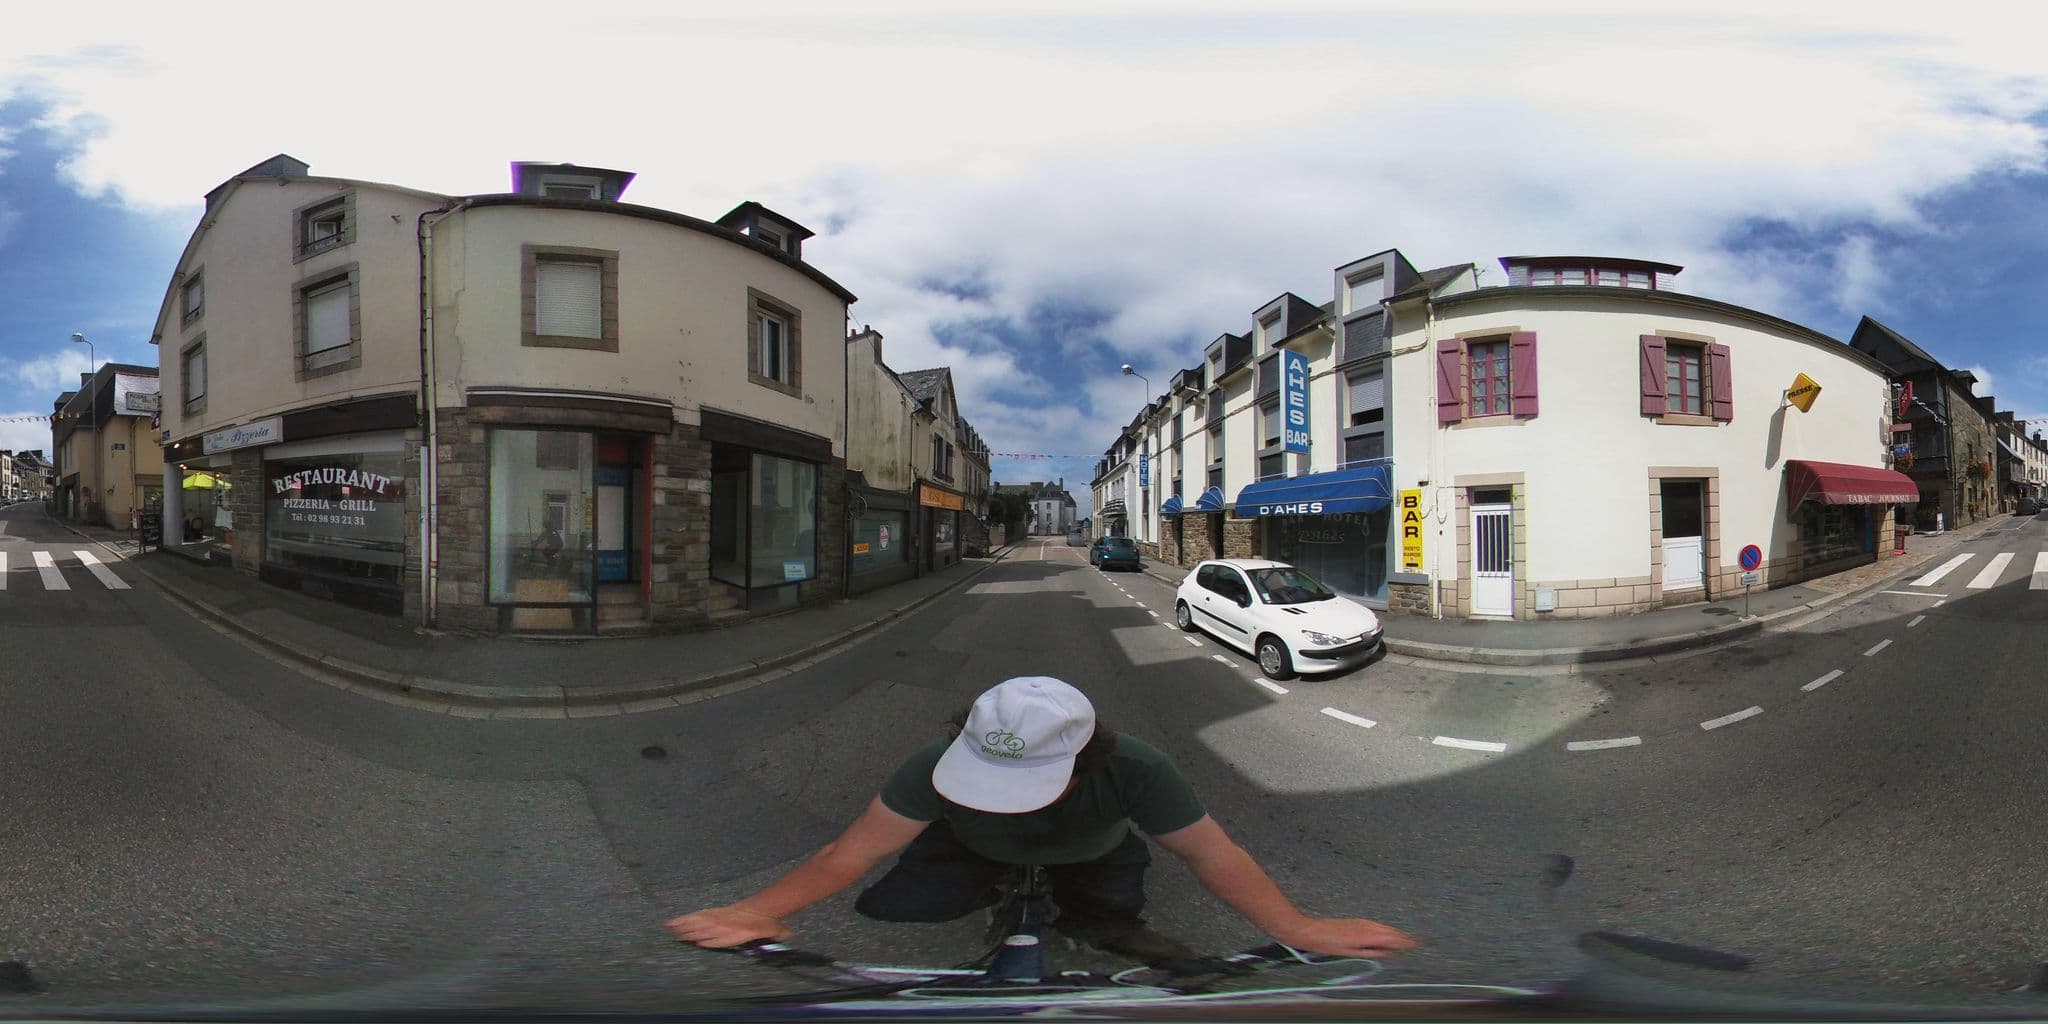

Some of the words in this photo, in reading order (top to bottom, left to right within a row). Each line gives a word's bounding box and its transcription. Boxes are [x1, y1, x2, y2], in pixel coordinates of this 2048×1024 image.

[1289, 358, 1304, 426] AHES
[1788, 385, 1813, 399] PRESSE
[231, 426, 270, 445] Pizzeria
[1286, 429, 1308, 446] BAR
[1140, 455, 1148, 486] HOTEL
[274, 468, 390, 494] RESTAURANT
[284, 499, 330, 510] PIZZERIA
[340, 500, 376, 511] GRILL
[1848, 495, 1873, 503] TABAC
[1260, 502, 1323, 515] D'AHES
[308, 514, 316, 522] 02
[318, 515, 328, 523] 98
[330, 515, 340, 523] 93
[342, 516, 352, 525] 21
[354, 517, 365, 525] 31
[1404, 496, 1419, 539] BAR
[981, 745, 1022, 759] geovelo
